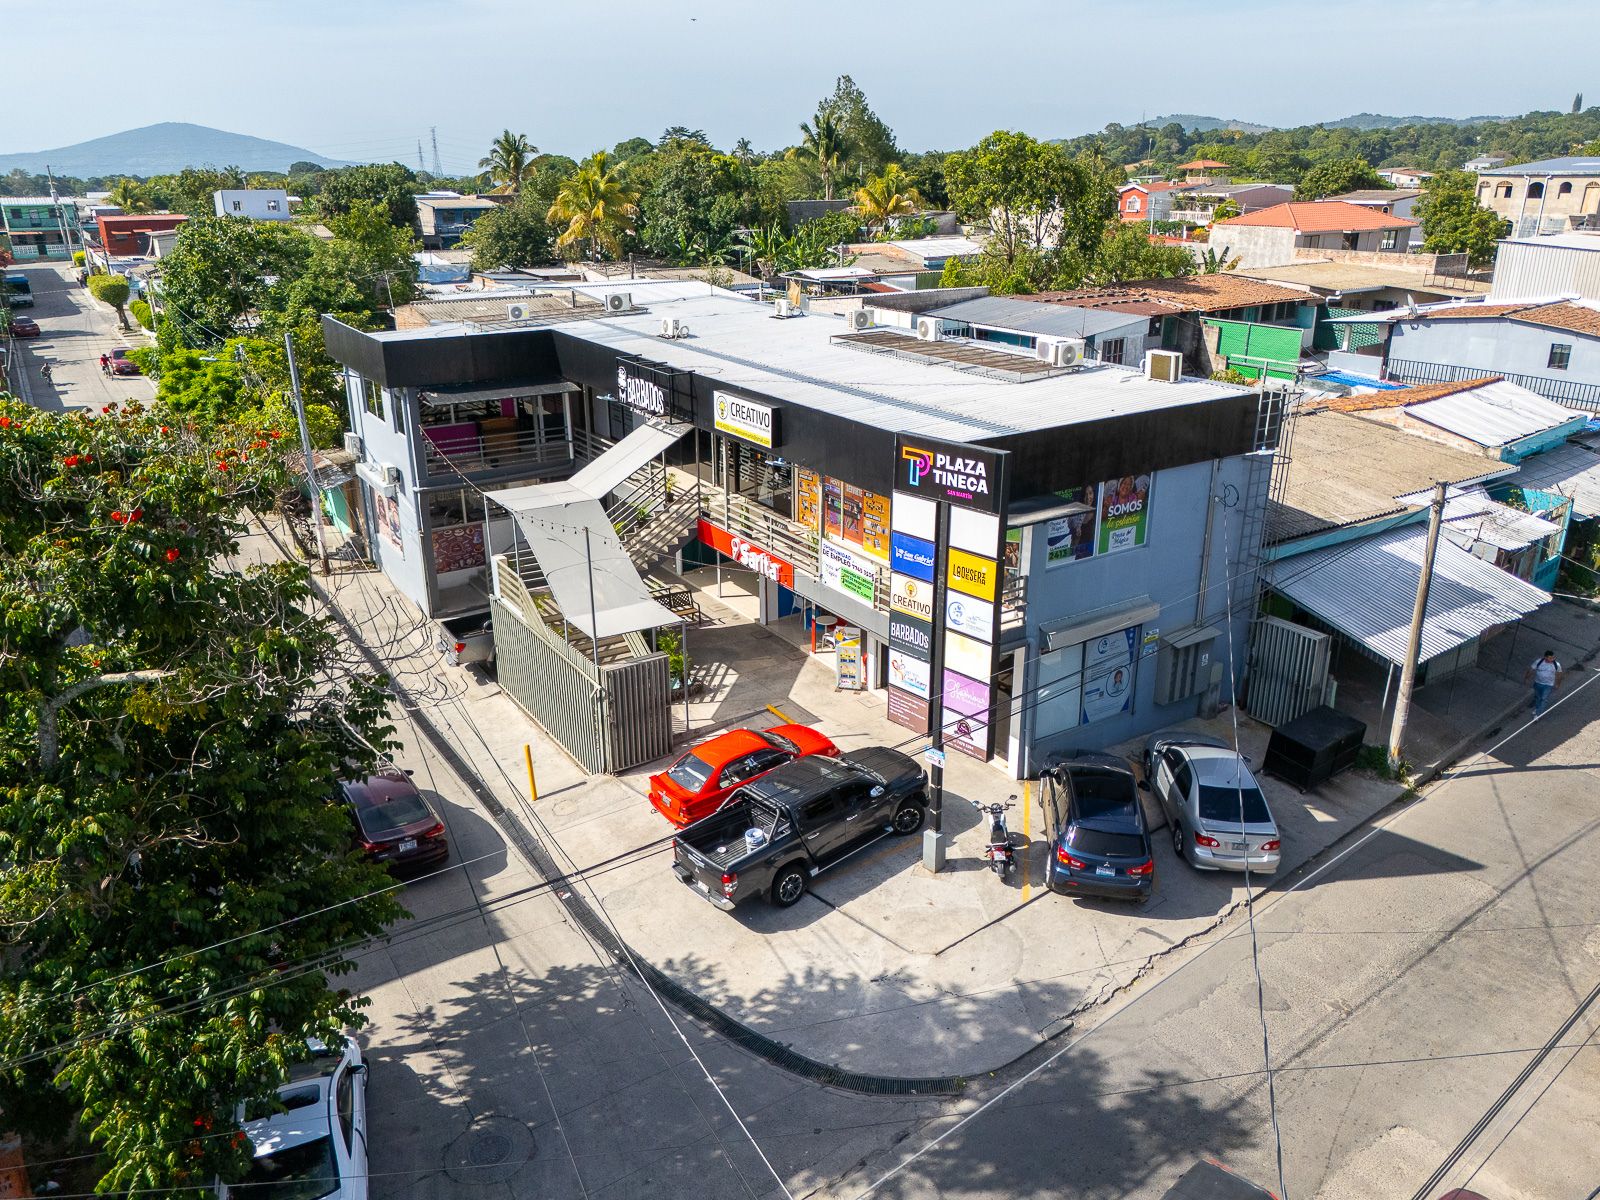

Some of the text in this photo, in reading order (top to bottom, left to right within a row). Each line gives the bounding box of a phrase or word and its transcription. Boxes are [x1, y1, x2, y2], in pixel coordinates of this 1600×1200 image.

[626, 378, 664, 414] BARBADOS
[731, 402, 770, 428] CREATIVO
[936, 453, 987, 478] PLAZA
[932, 469, 989, 494] TINECA
[1108, 500, 1143, 517] SOMOS
[831, 552, 851, 567] EMPLEO
[903, 550, 914, 560] San
[914, 553, 935, 566] Gabriel
[893, 593, 931, 615] CREATIVO
[891, 622, 929, 648] BARBADOS
